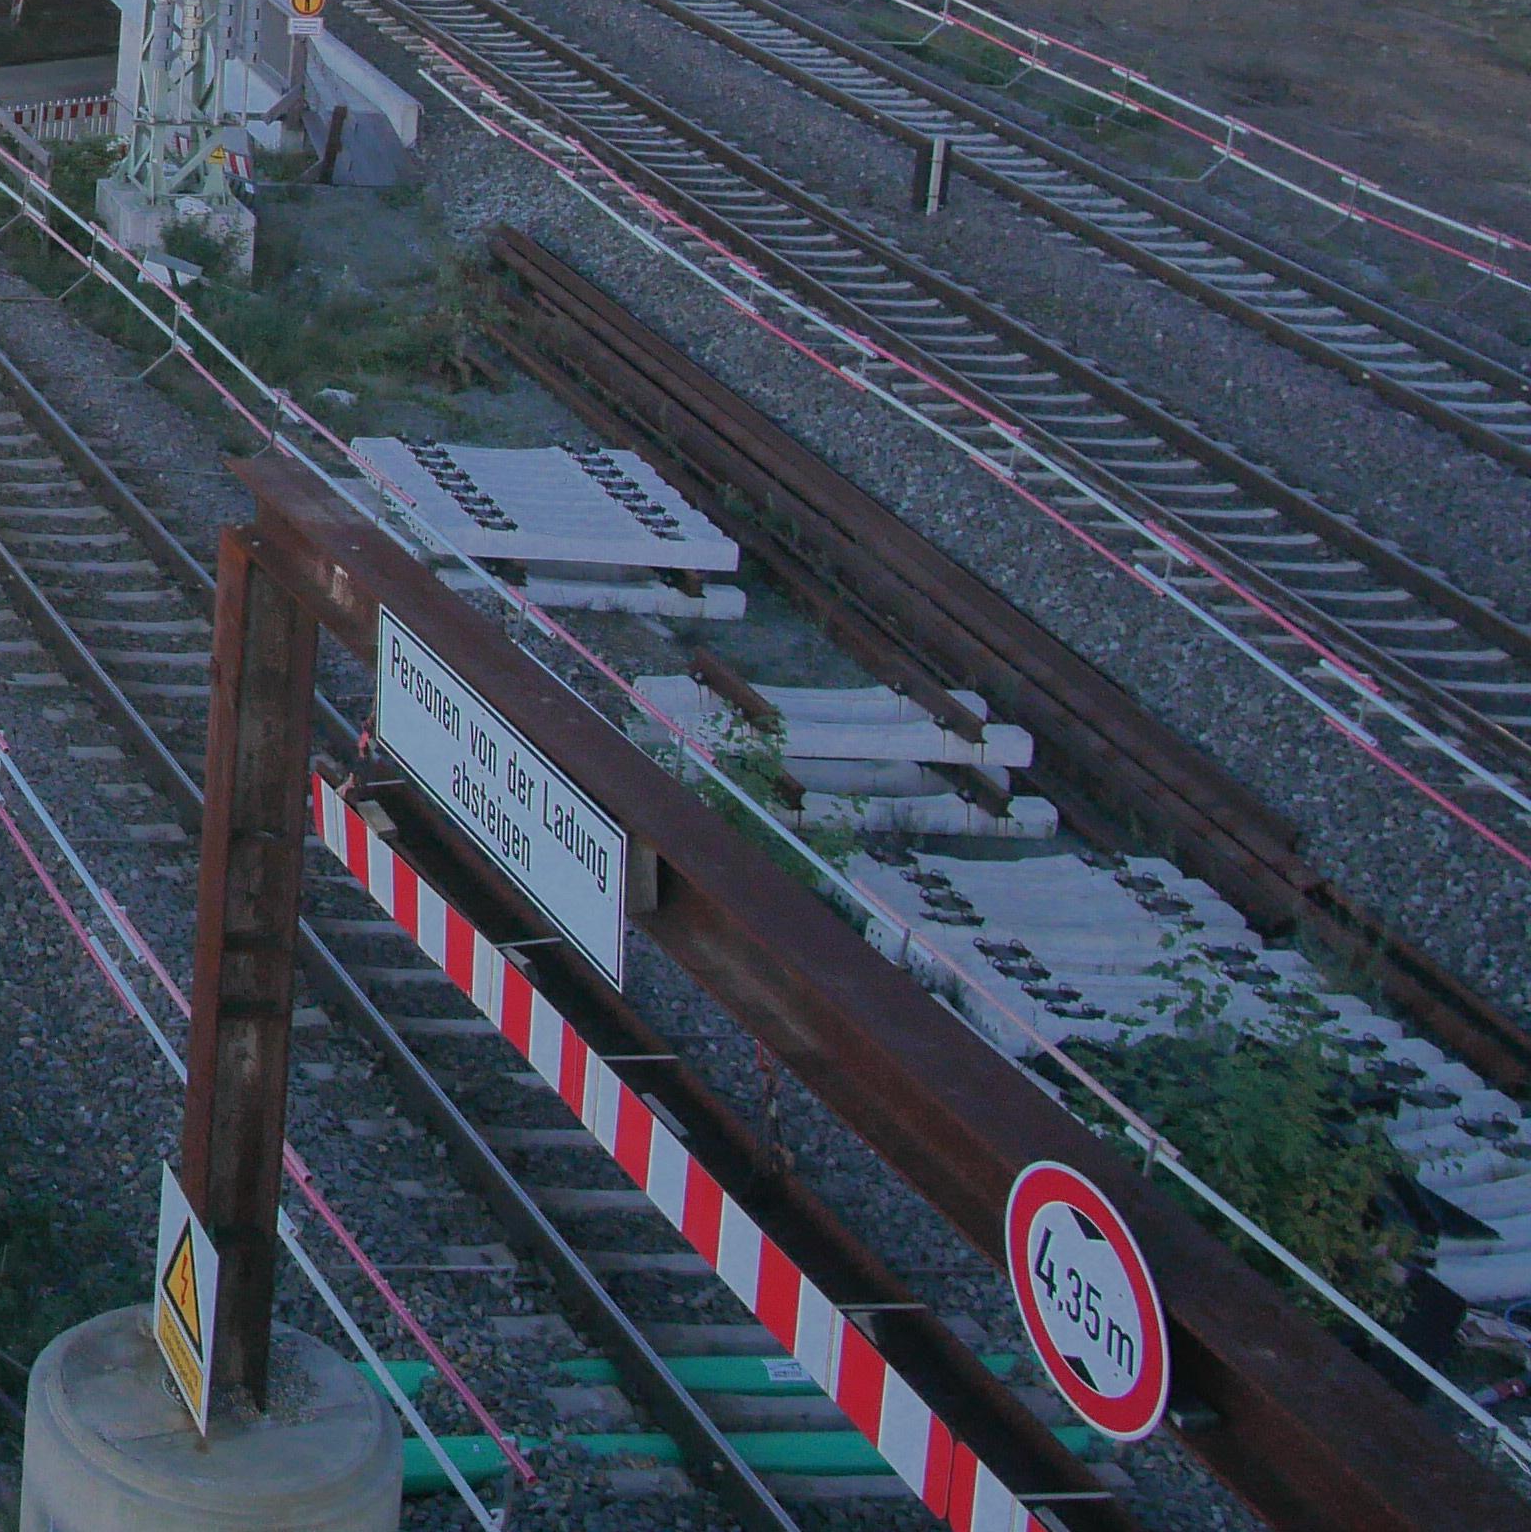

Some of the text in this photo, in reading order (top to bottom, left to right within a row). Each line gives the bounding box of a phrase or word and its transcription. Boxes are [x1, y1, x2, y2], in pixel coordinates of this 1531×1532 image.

[390, 634, 610, 895] Personen von der Ladung
[452, 761, 532, 872] absteigen
